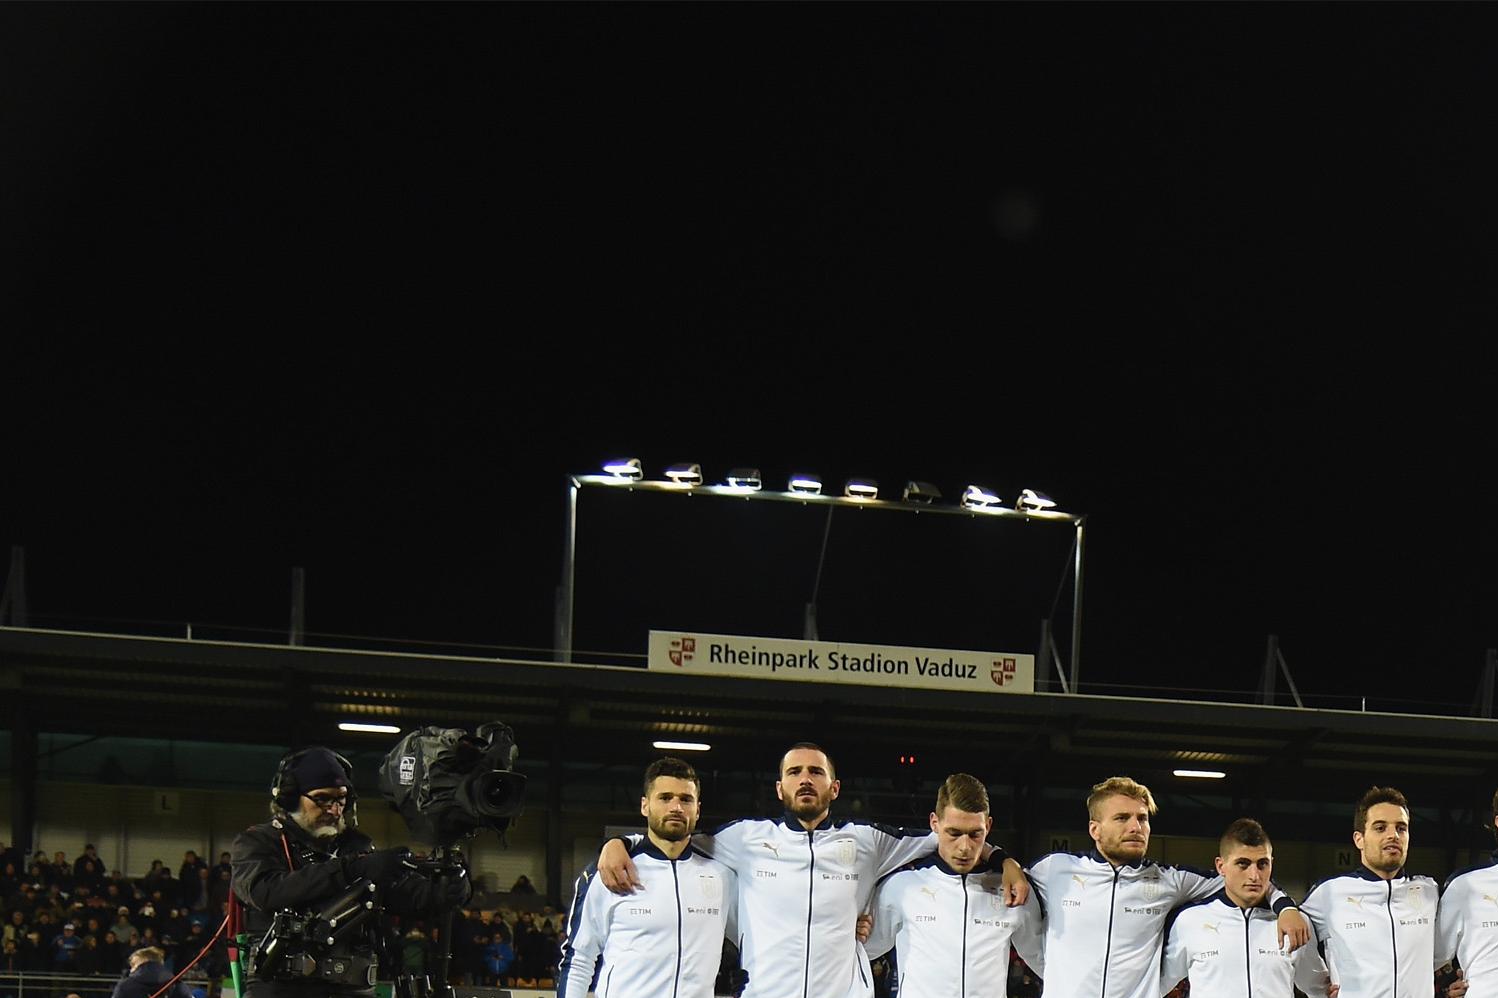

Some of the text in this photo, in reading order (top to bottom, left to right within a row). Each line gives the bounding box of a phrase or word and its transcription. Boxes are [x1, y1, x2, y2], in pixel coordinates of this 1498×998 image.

[709, 644, 977, 680] Rheinpark Stadion Vaduz
